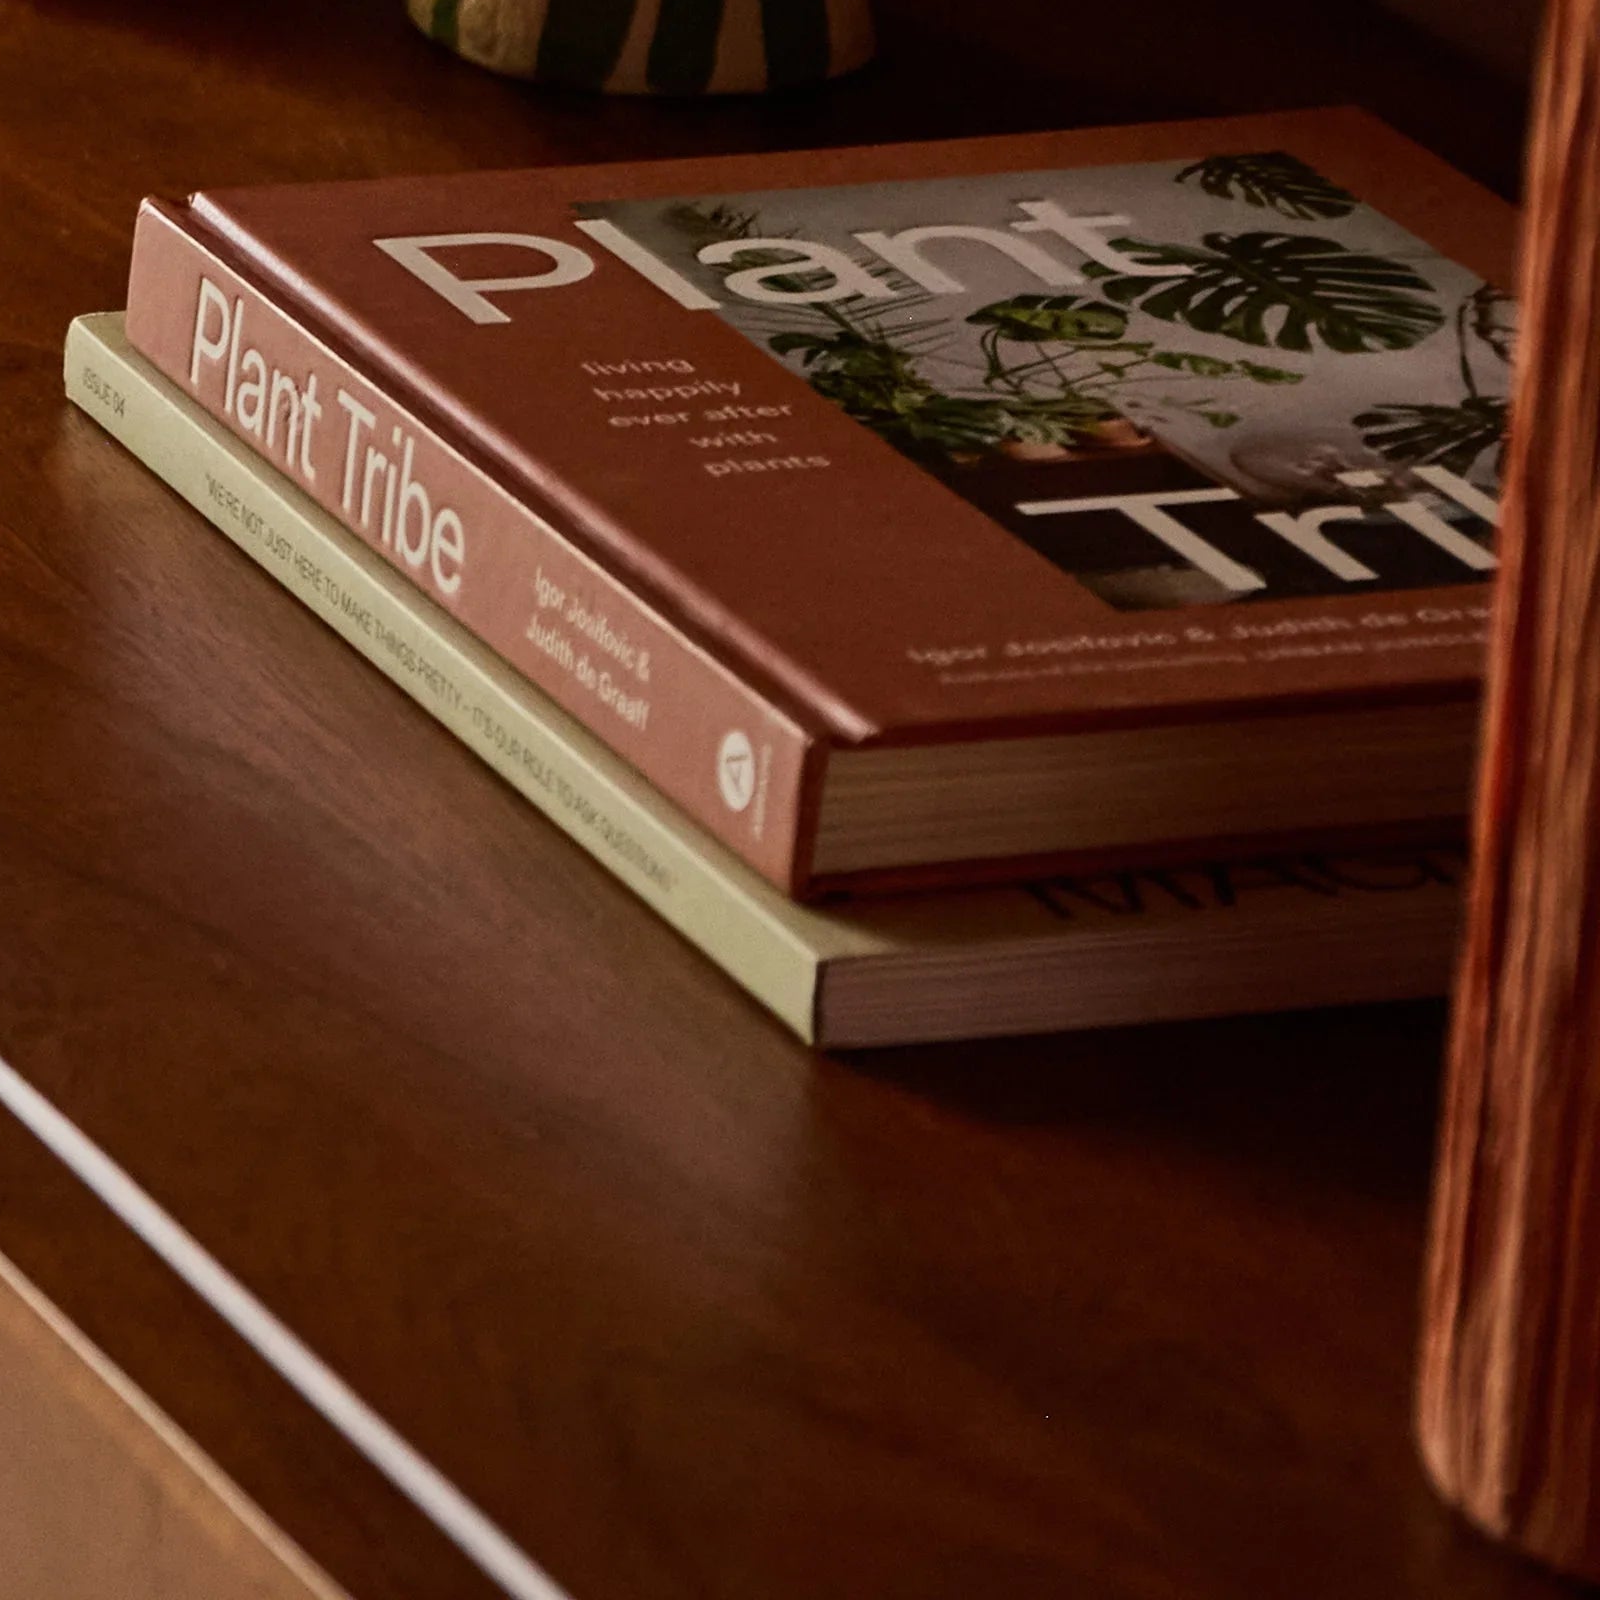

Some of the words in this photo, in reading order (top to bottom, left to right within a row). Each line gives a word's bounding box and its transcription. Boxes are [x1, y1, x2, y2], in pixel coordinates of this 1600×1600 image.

[372, 199, 1195, 326] Plant
[581, 358, 696, 376] living
[593, 379, 741, 401] happily
[607, 410, 692, 428] ever
[702, 404, 793, 422] after
[190, 275, 322, 483] Plant
[337, 388, 466, 595] Tribe
[687, 430, 779, 449] with
[702, 455, 832, 479] plants
[1014, 465, 1501, 592] Tri
[534, 565, 566, 610] Igor
[526, 614, 575, 673] Judith
[575, 654, 597, 691] de
